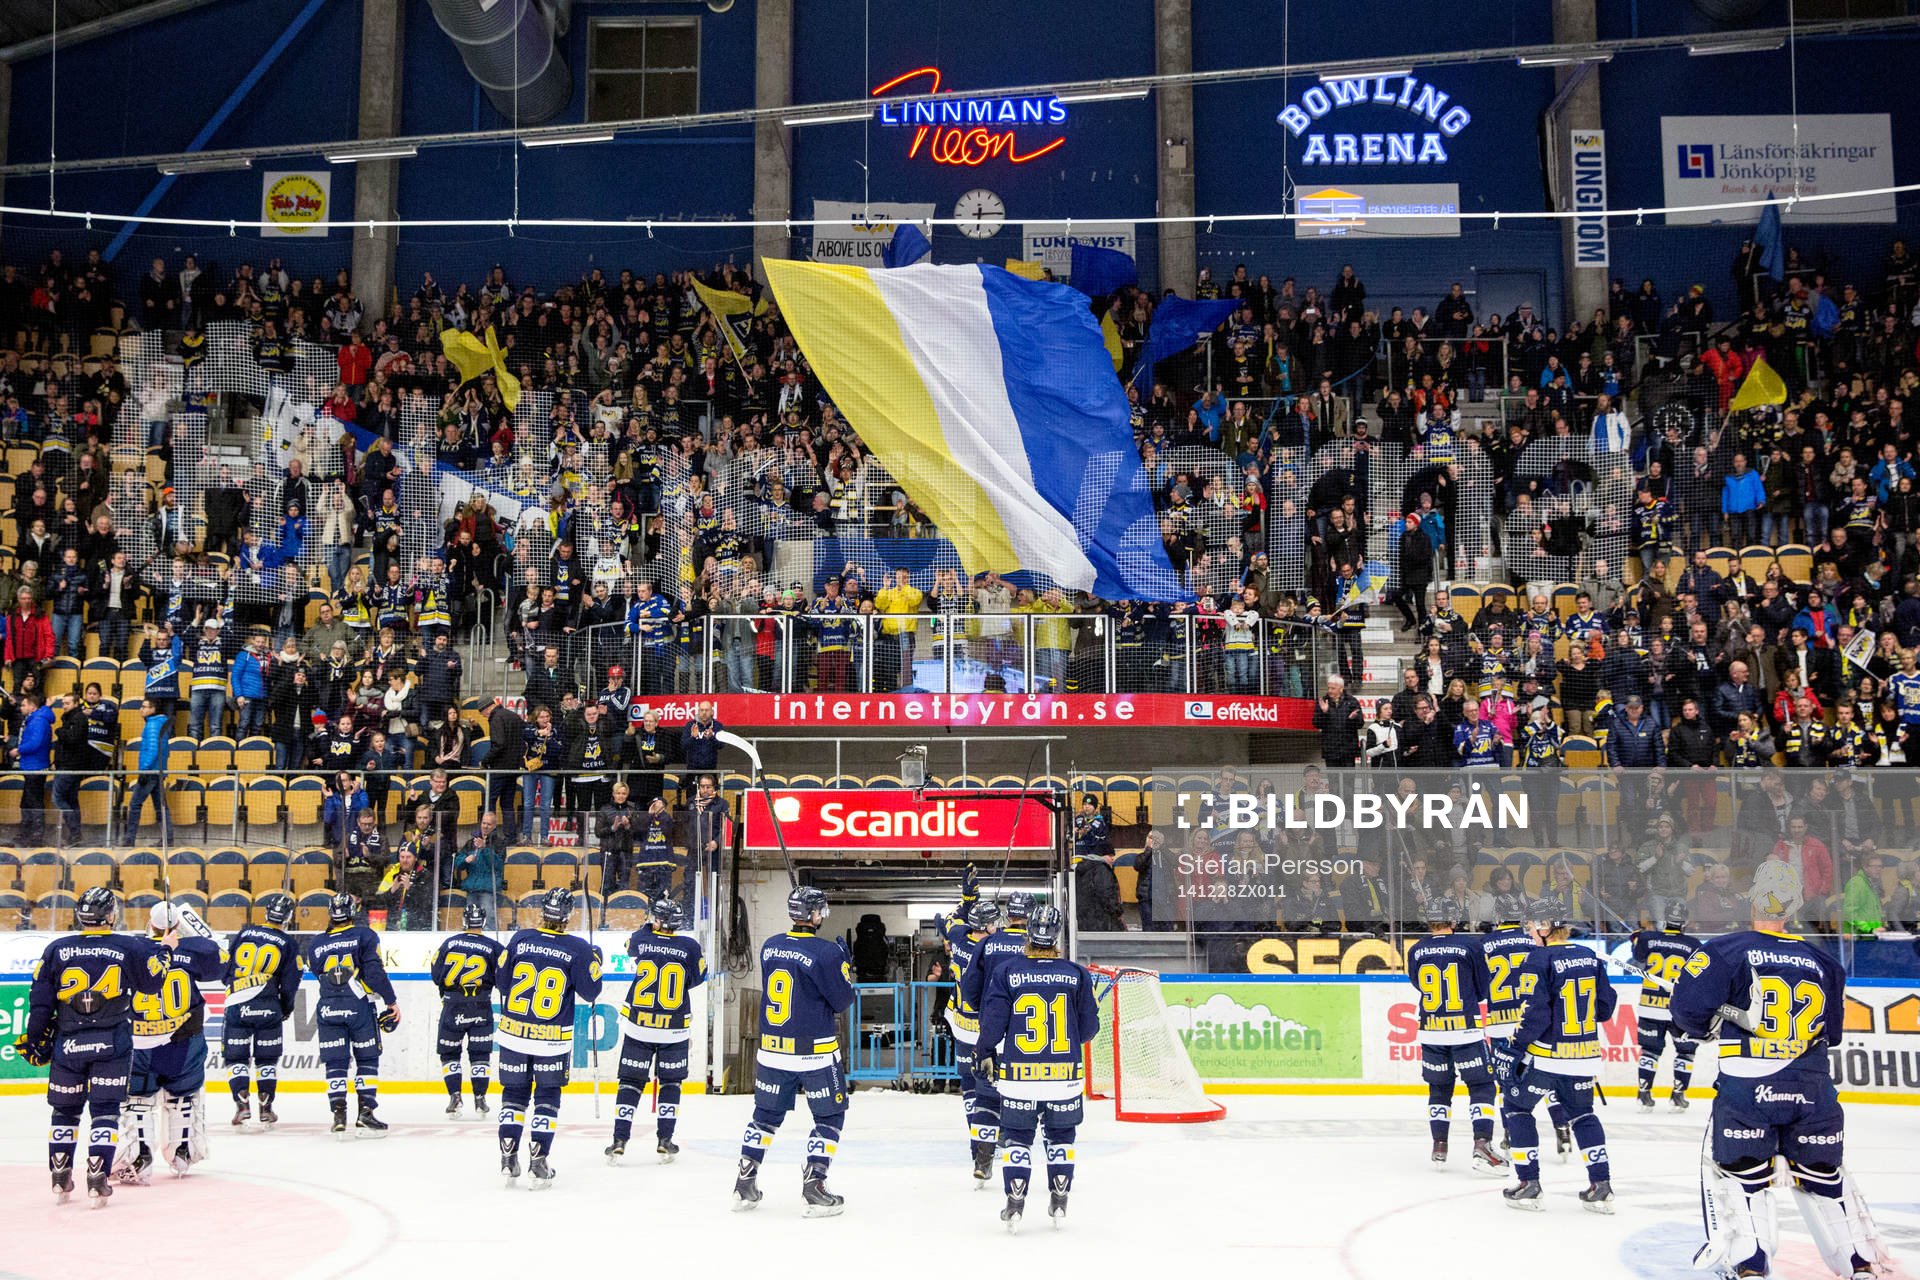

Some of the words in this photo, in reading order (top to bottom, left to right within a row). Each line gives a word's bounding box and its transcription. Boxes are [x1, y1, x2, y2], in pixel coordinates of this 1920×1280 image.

[879, 98, 1067, 125] LINNMANS
[1277, 77, 1471, 138] BOWLING
[1302, 132, 1448, 165] ARENA
[1720, 142, 1878, 163] Länsförsäkringar
[1720, 162, 1817, 183] Jönköping
[816, 240, 855, 258] ABOVE
[857, 240, 872, 258] US
[1216, 702, 1279, 722] effektid
[819, 802, 980, 837] Scandic
[71, 947, 125, 962] Husqvarna
[234, 942, 282, 978] 90
[526, 943, 573, 963] Husqvarna
[644, 943, 688, 959] Husqvarna
[771, 947, 813, 968] Husqvarna
[1420, 946, 1467, 959] Husqvarna
[444, 952, 488, 988] 72
[1021, 973, 1078, 986] Husqvarna
[57, 964, 123, 1004] 24
[132, 967, 192, 1020] 40
[507, 961, 568, 1020] 28
[632, 959, 686, 1011] 20
[766, 968, 794, 1027] 9
[1417, 962, 1464, 1013] 91
[1559, 976, 1597, 1036] 17
[1756, 976, 1826, 1042] 32
[1014, 992, 1071, 1054] 31
[659, 1057, 688, 1070] essell
[91, 1075, 128, 1088] essell
[1003, 1099, 1038, 1112] essell
[1797, 1130, 1844, 1145] essell
